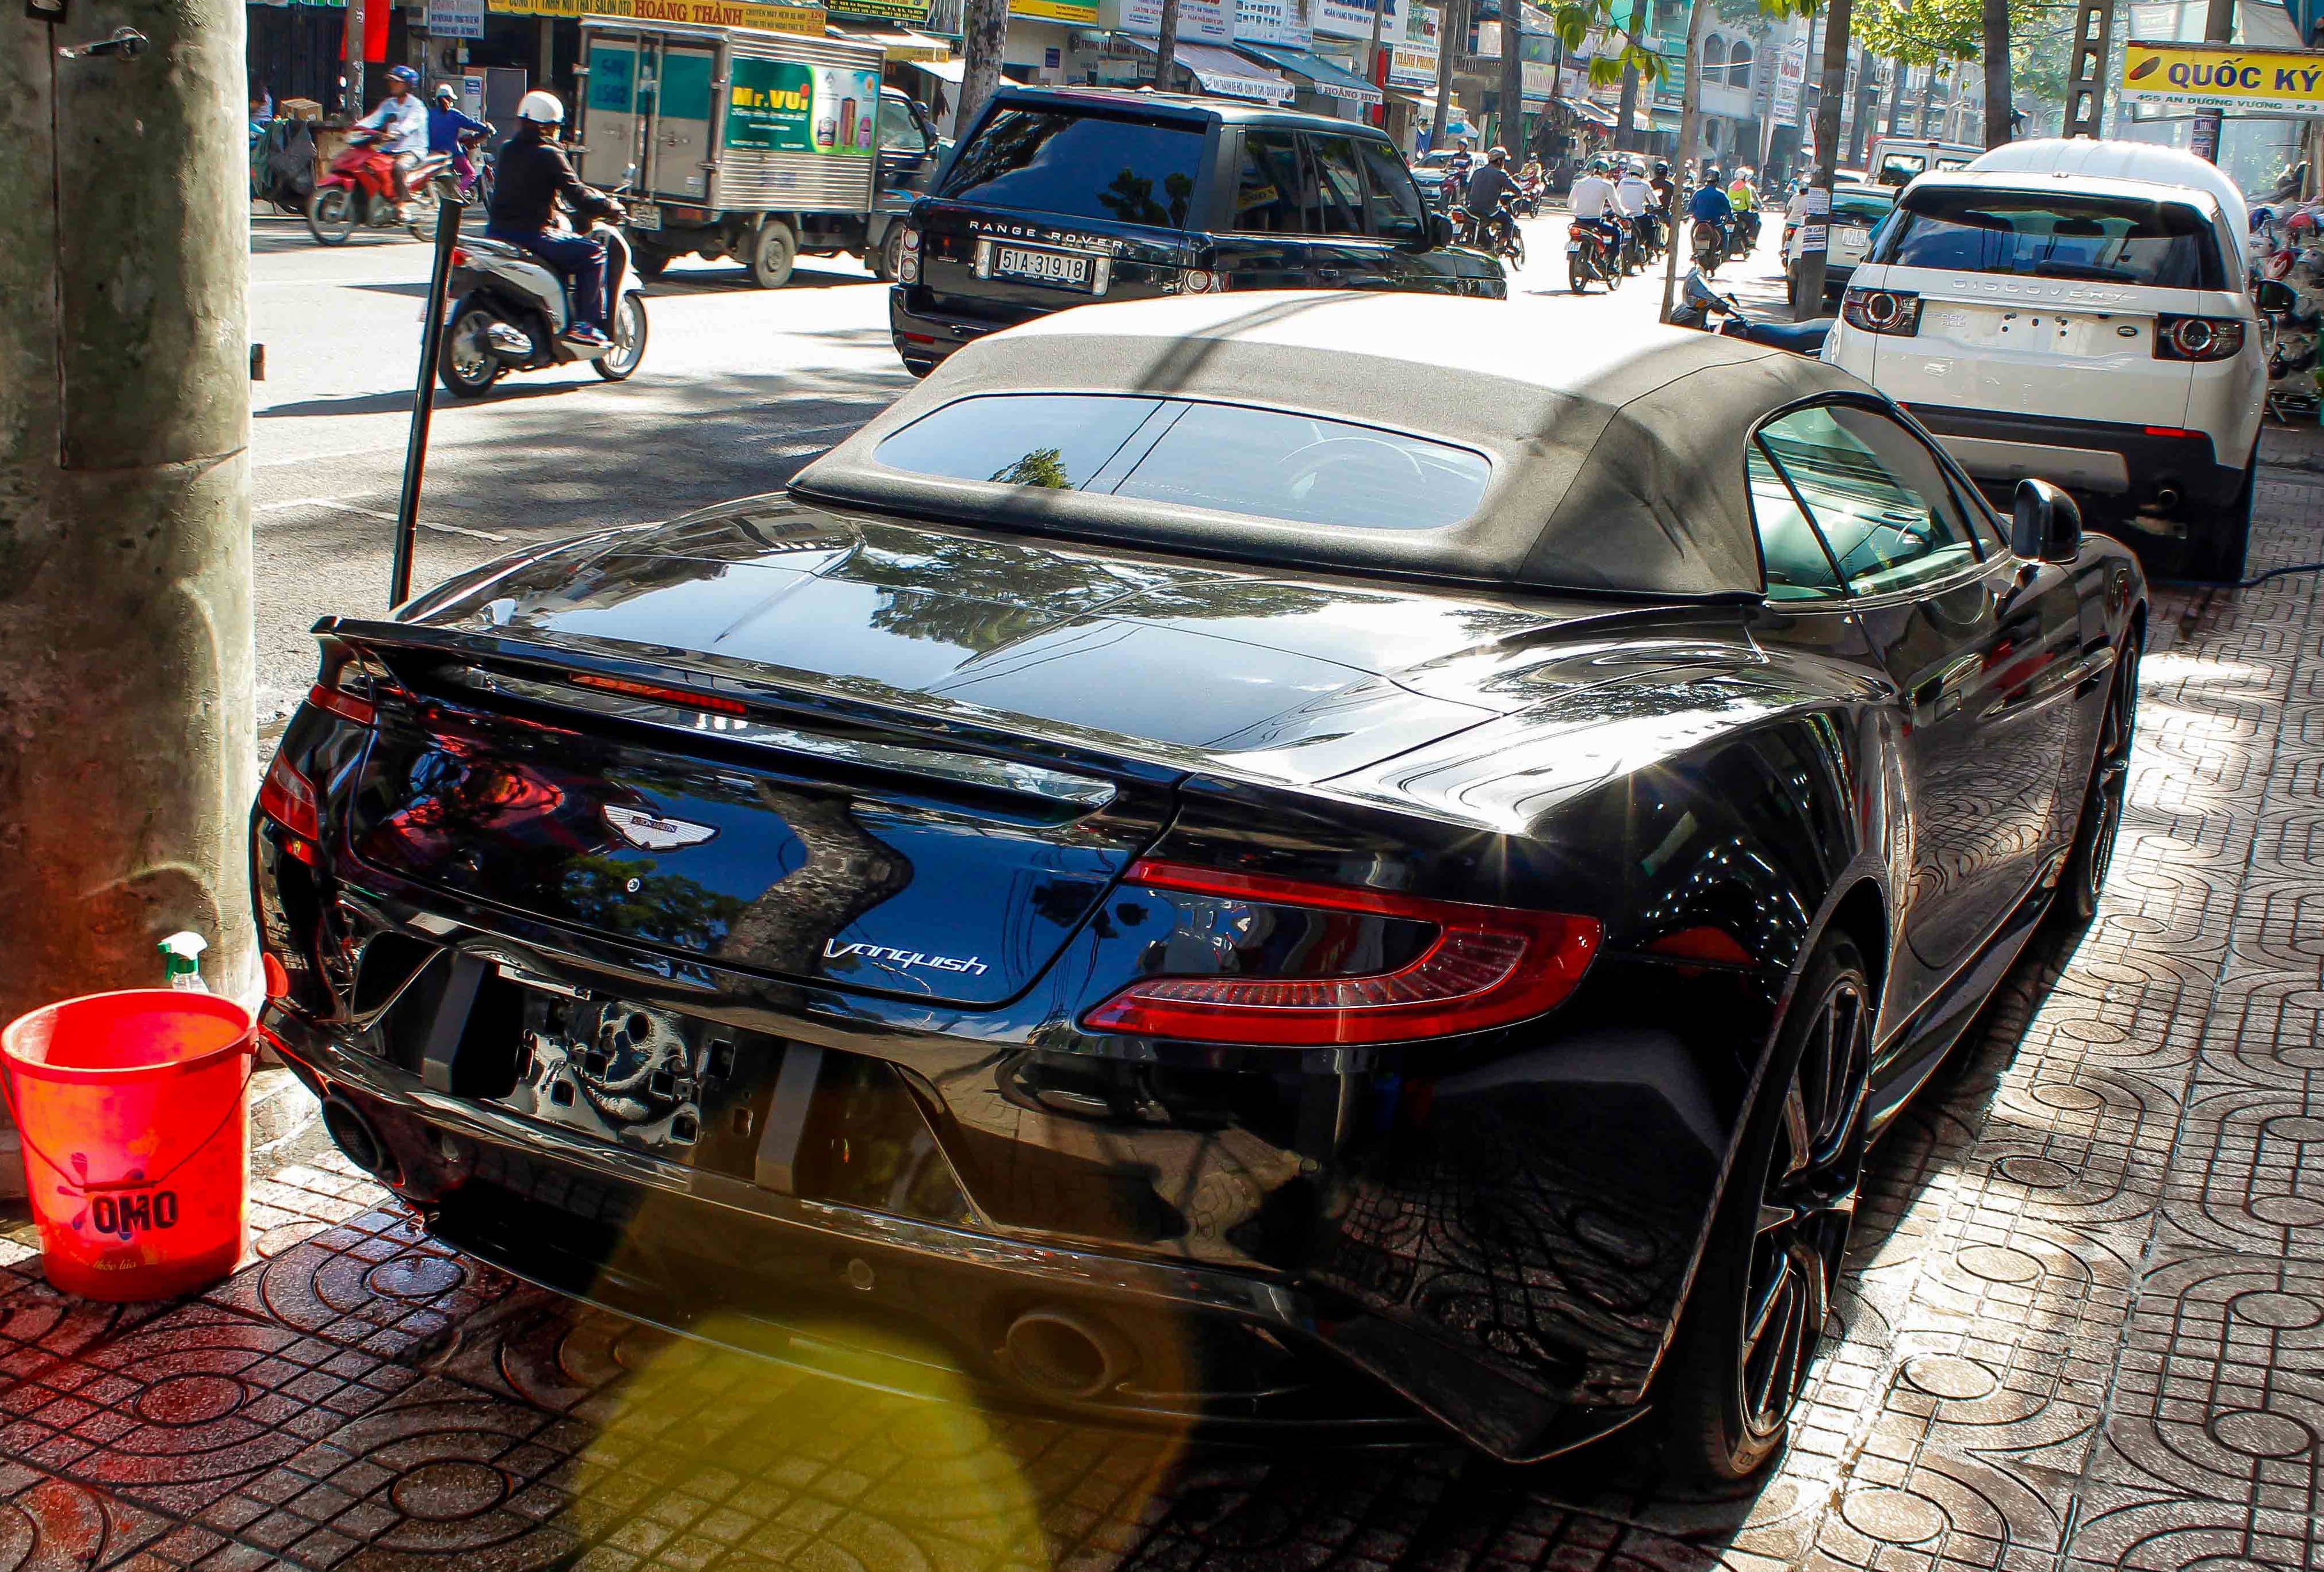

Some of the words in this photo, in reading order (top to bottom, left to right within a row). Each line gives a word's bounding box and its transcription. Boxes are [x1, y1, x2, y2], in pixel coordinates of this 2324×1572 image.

[693, 1, 744, 25] THÀNH
[1417, 55, 1436, 70] PHONG
[2168, 57, 2262, 89] QUỐC
[2135, 94, 2162, 102] 455
[2165, 95, 2184, 103] AN
[2187, 97, 2233, 107] DƯƠNG
[2237, 99, 2283, 109] VƯƠNG
[970, 221, 1036, 237] RANGE
[1051, 232, 1123, 249] ROVER
[1002, 250, 1083, 278] 51A-319.18
[1952, 279, 2129, 301] DISCOVERY
[634, 818, 653, 827] ASTON
[653, 822, 677, 833] MARTIN
[823, 938, 989, 976] Vanquish
[91, 1190, 178, 1234] OMO
